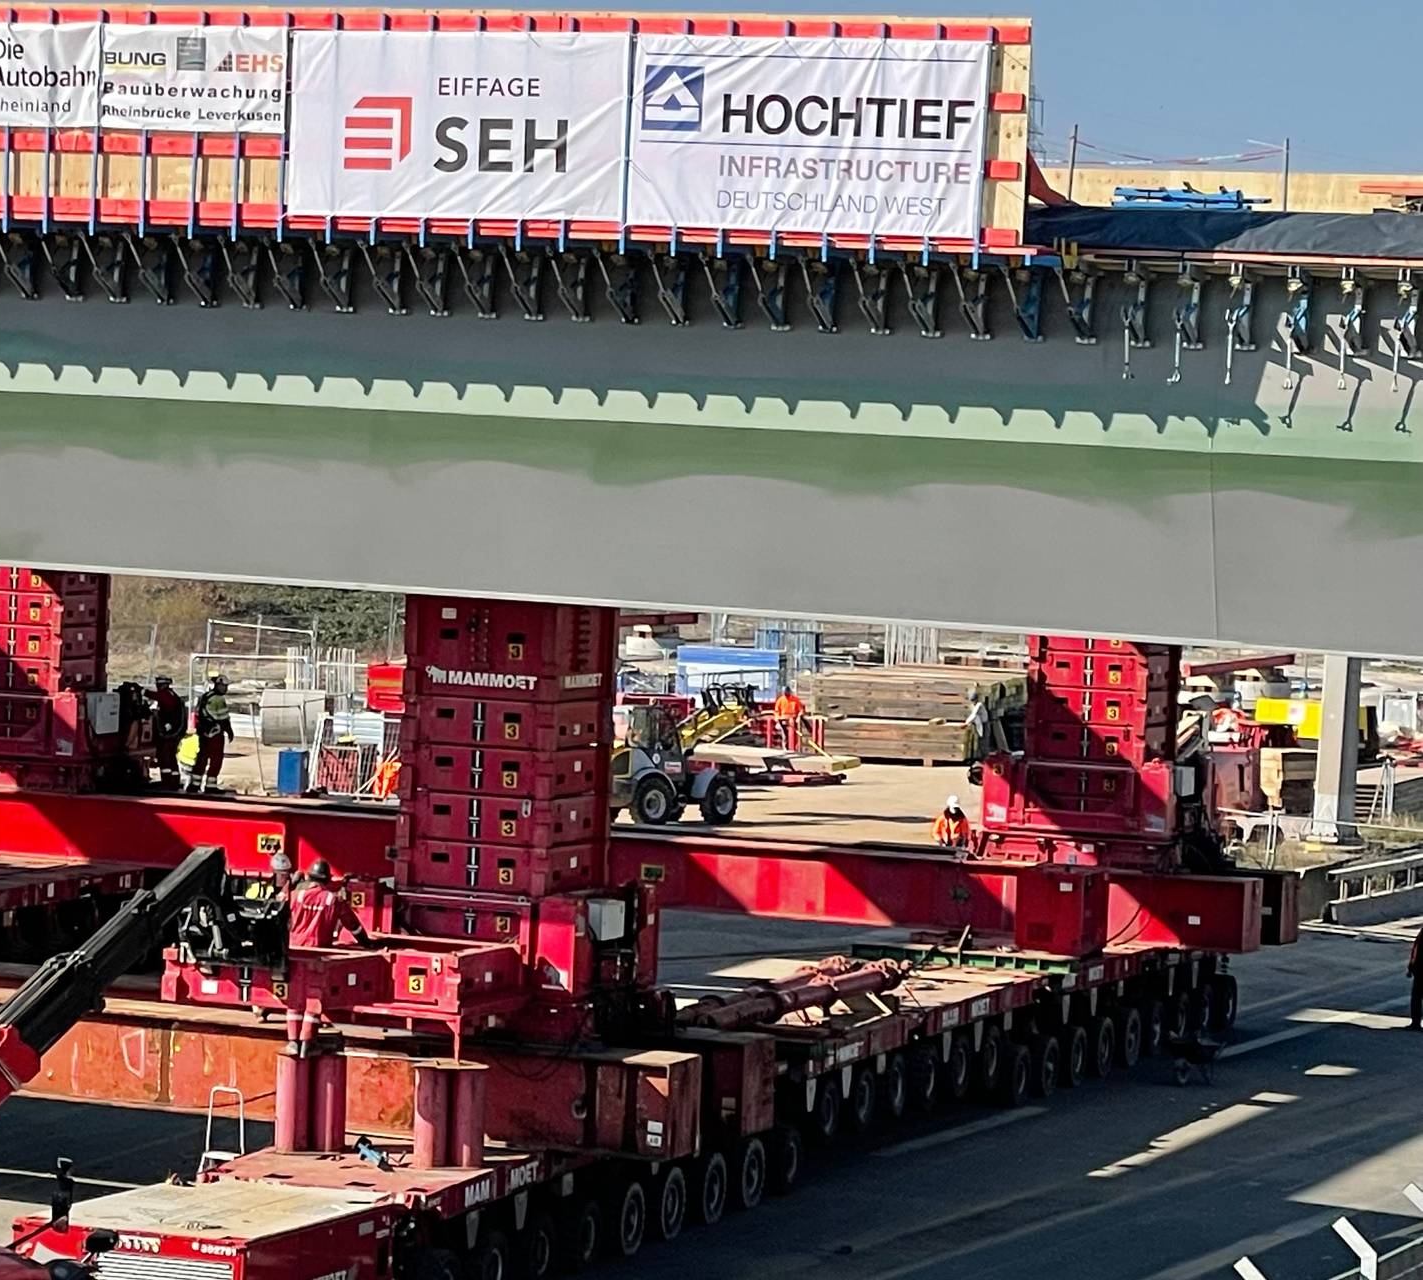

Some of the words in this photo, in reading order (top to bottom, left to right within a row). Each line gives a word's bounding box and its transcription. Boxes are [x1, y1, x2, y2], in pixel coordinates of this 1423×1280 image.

[104, 51, 166, 66] BUNG
[235, 53, 284, 73] EHS
[102, 80, 282, 102] Bauüberwachung
[438, 77, 540, 97] EIFFAGE
[102, 105, 191, 121] Rheinbrücke
[198, 108, 282, 122] Leverkusen
[722, 93, 975, 140] HOCHTIEF
[433, 116, 569, 173] SEH
[719, 154, 972, 185] INFRASTRUCTURE
[717, 190, 878, 215] DEUTSCHLAND
[885, 195, 946, 217] WEST
[448, 671, 537, 690] MAMMOET
[465, 1179, 490, 1208] MAM
[510, 1160, 539, 1189] MOET
